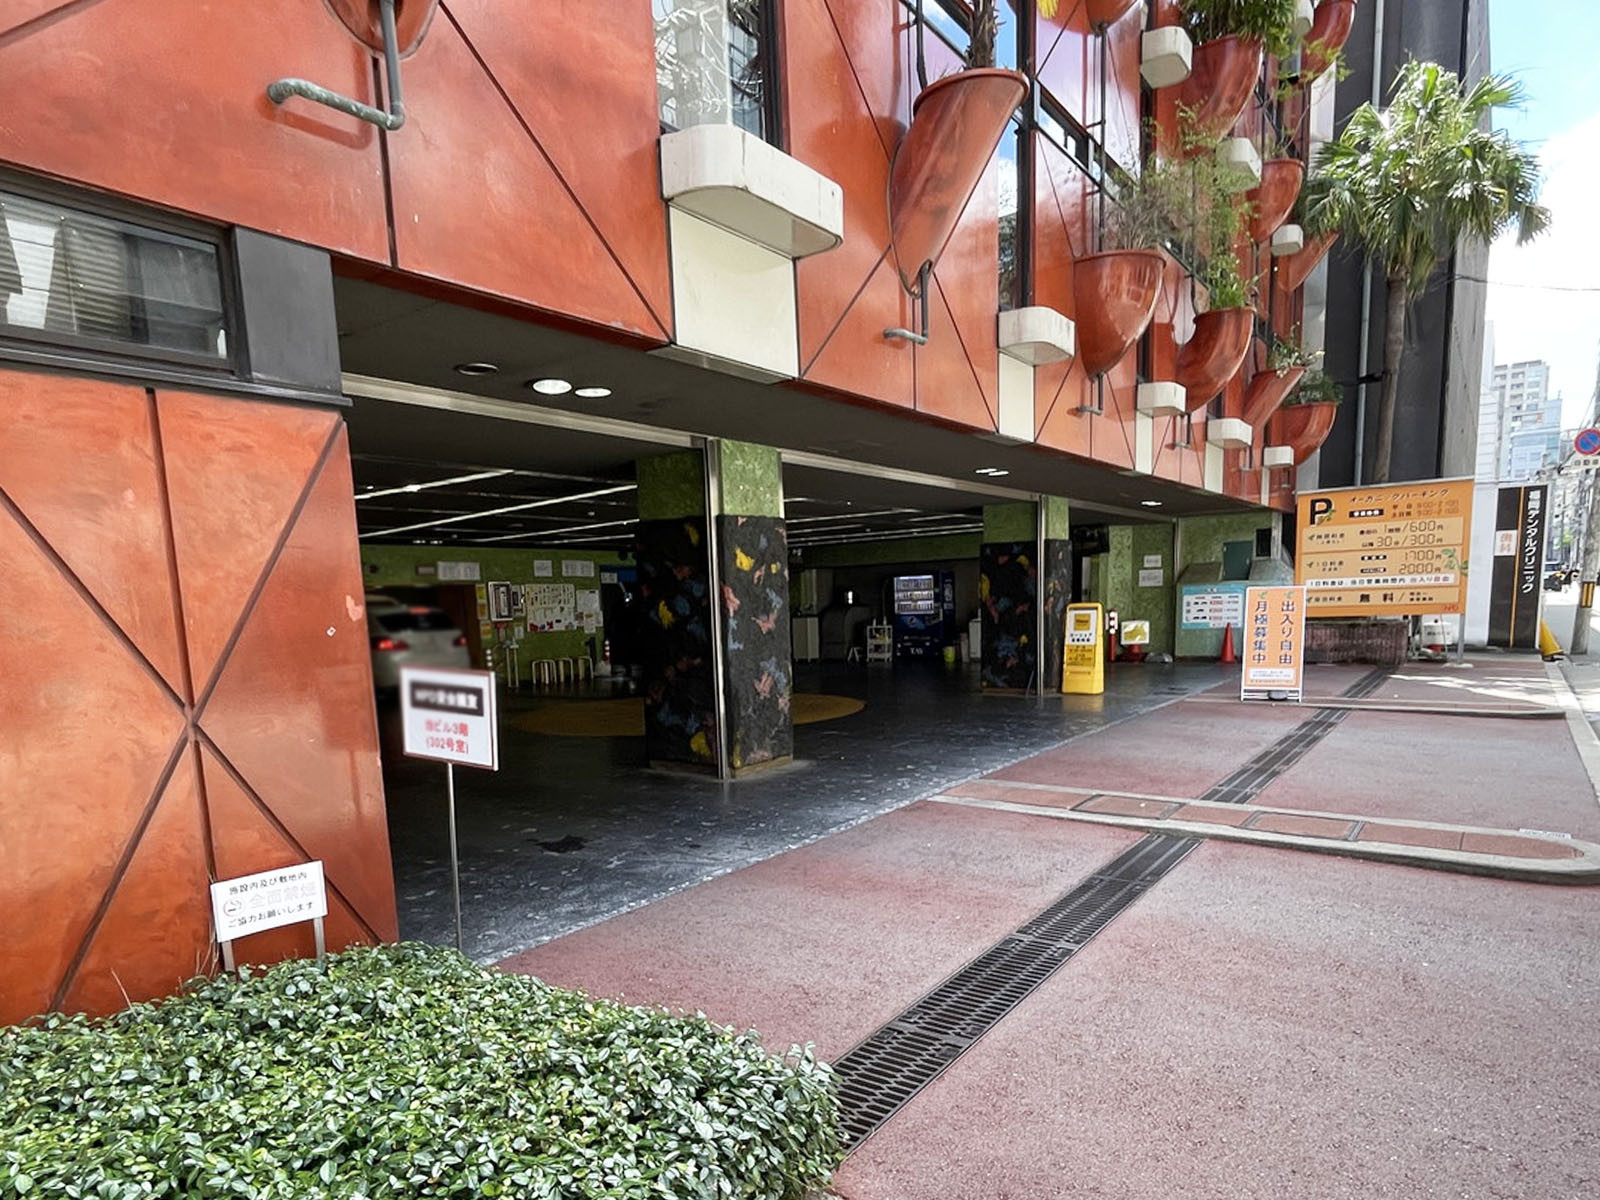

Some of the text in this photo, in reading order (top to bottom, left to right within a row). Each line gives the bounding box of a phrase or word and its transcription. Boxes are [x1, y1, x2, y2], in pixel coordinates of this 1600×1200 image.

[1310, 498, 1333, 525] P
[1252, 600, 1268, 664] 月極募集中
[1278, 600, 1295, 664] 出入り自由
